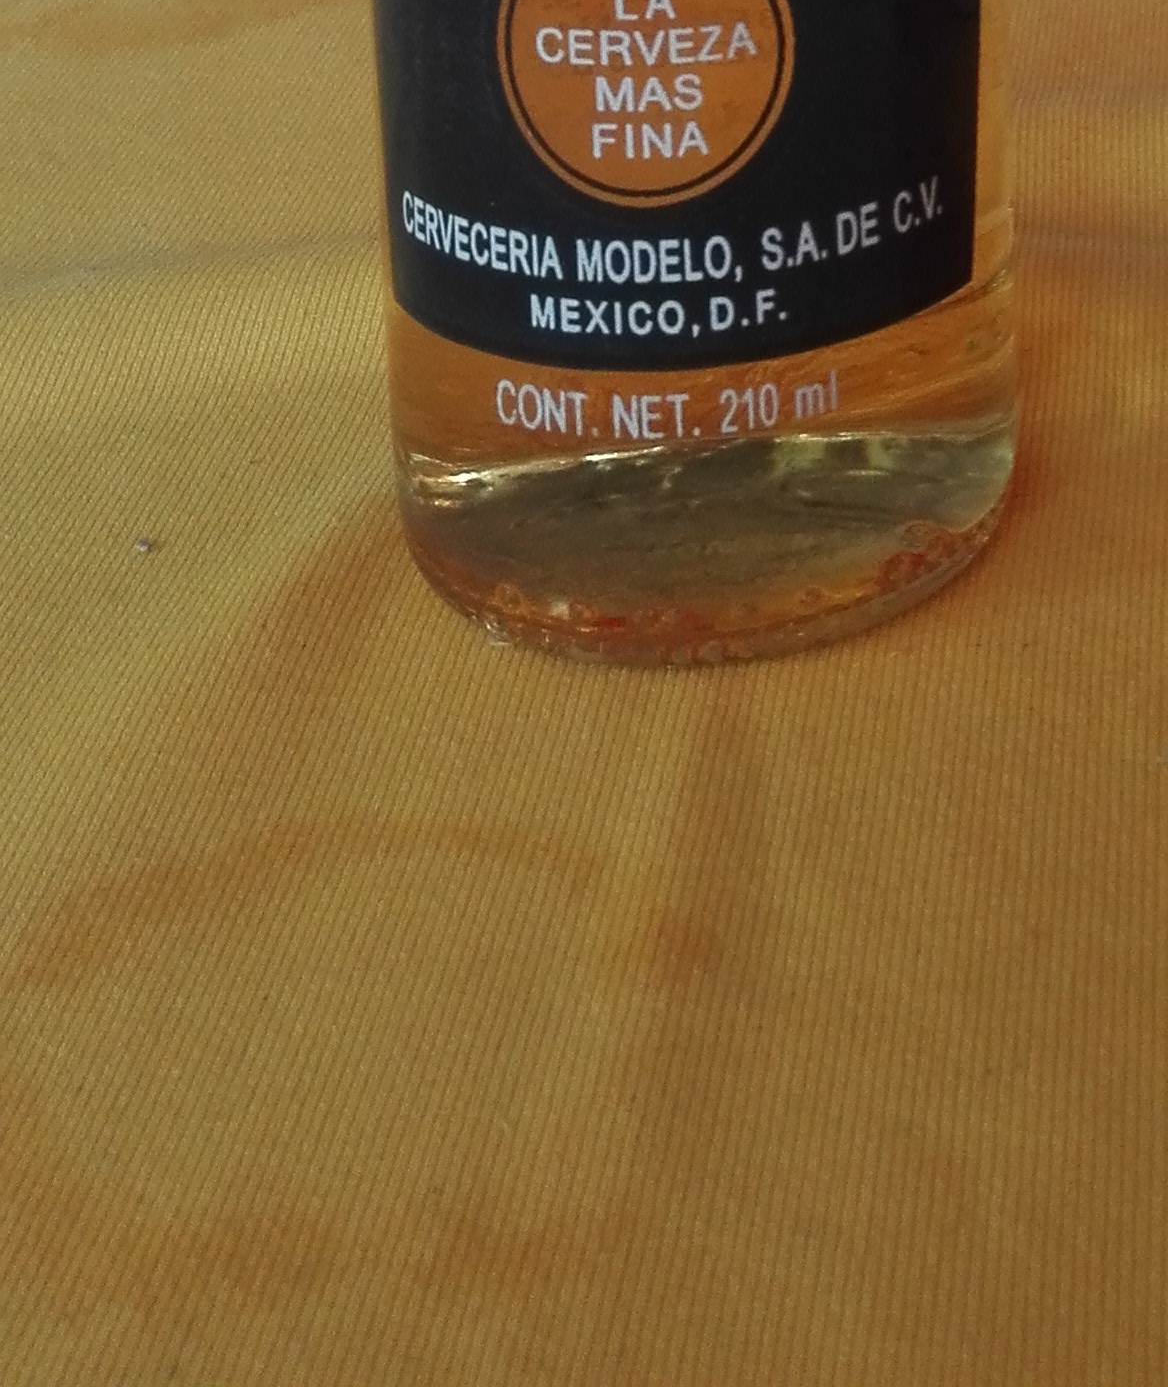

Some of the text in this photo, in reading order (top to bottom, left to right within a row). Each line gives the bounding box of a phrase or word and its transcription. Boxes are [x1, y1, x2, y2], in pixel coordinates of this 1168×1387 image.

[535, 22, 758, 66] CERVEZA
[594, 72, 704, 113] MAS
[591, 120, 710, 161] FINA
[401, 189, 564, 282] CERVECERIA
[576, 234, 744, 285] MODELO,
[836, 202, 881, 256] DE
[893, 174, 944, 234] C.V.
[529, 294, 701, 339] MEXICO,
[495, 369, 839, 442] CONT. NET. 210 ml
